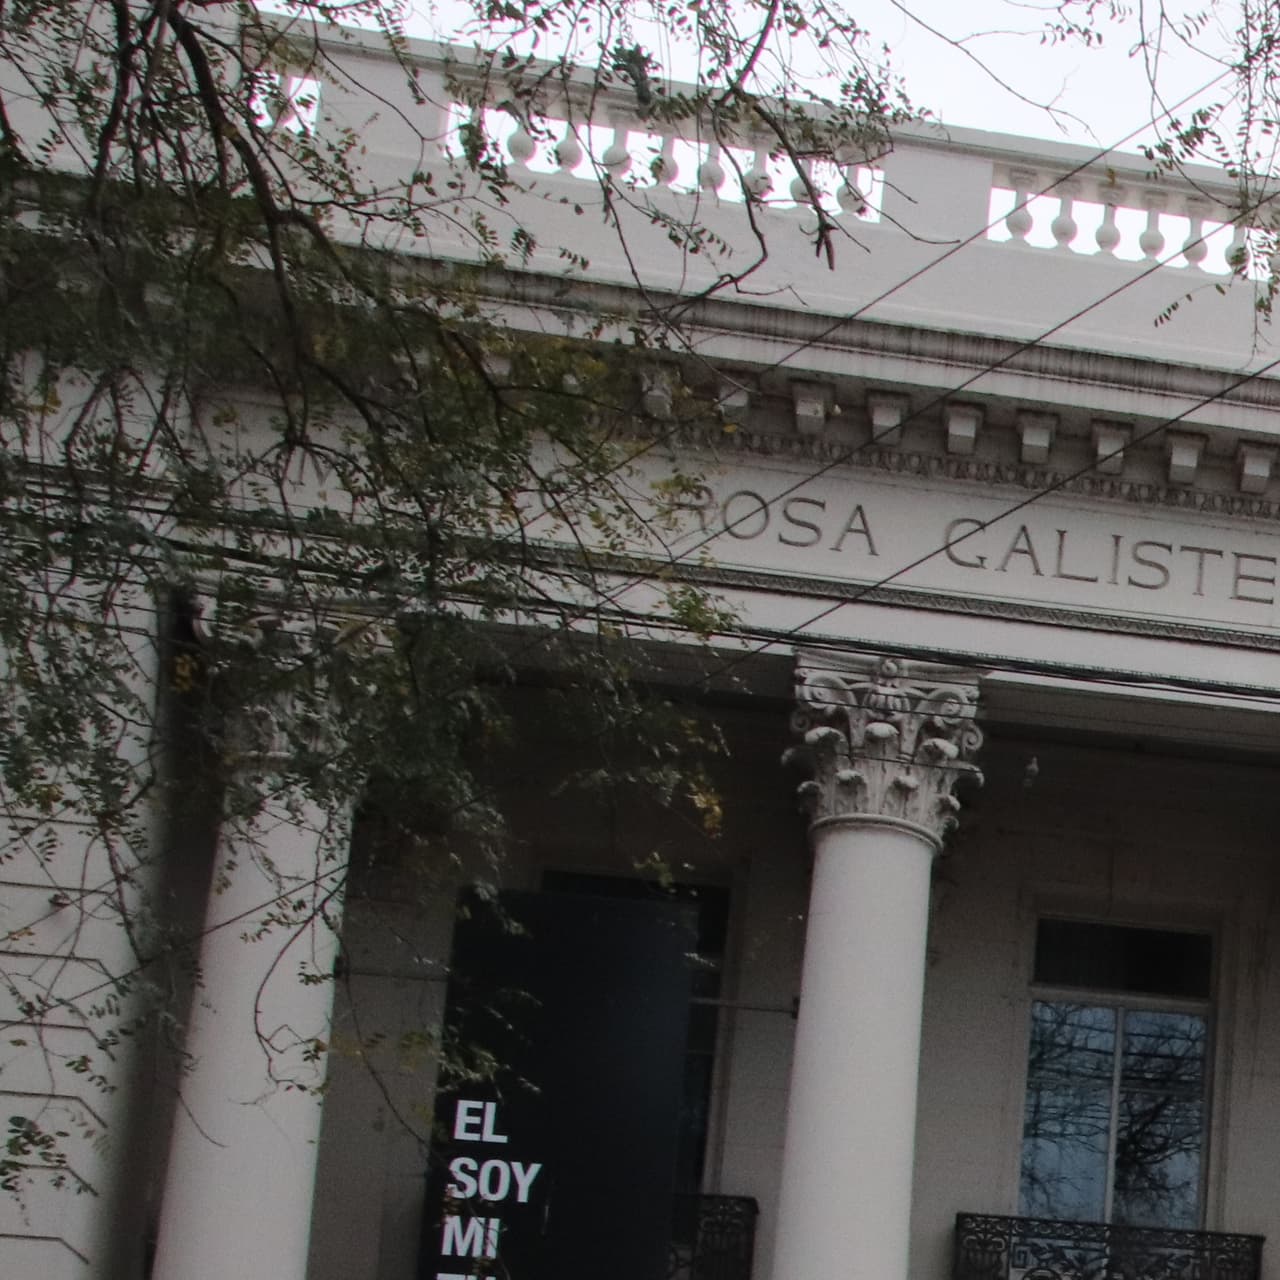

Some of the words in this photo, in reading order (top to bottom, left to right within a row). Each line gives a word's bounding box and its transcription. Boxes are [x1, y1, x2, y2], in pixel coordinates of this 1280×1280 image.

[453, 1098, 509, 1144] EL
[446, 1156, 542, 1204] SOY
[440, 1215, 501, 1260] MI
